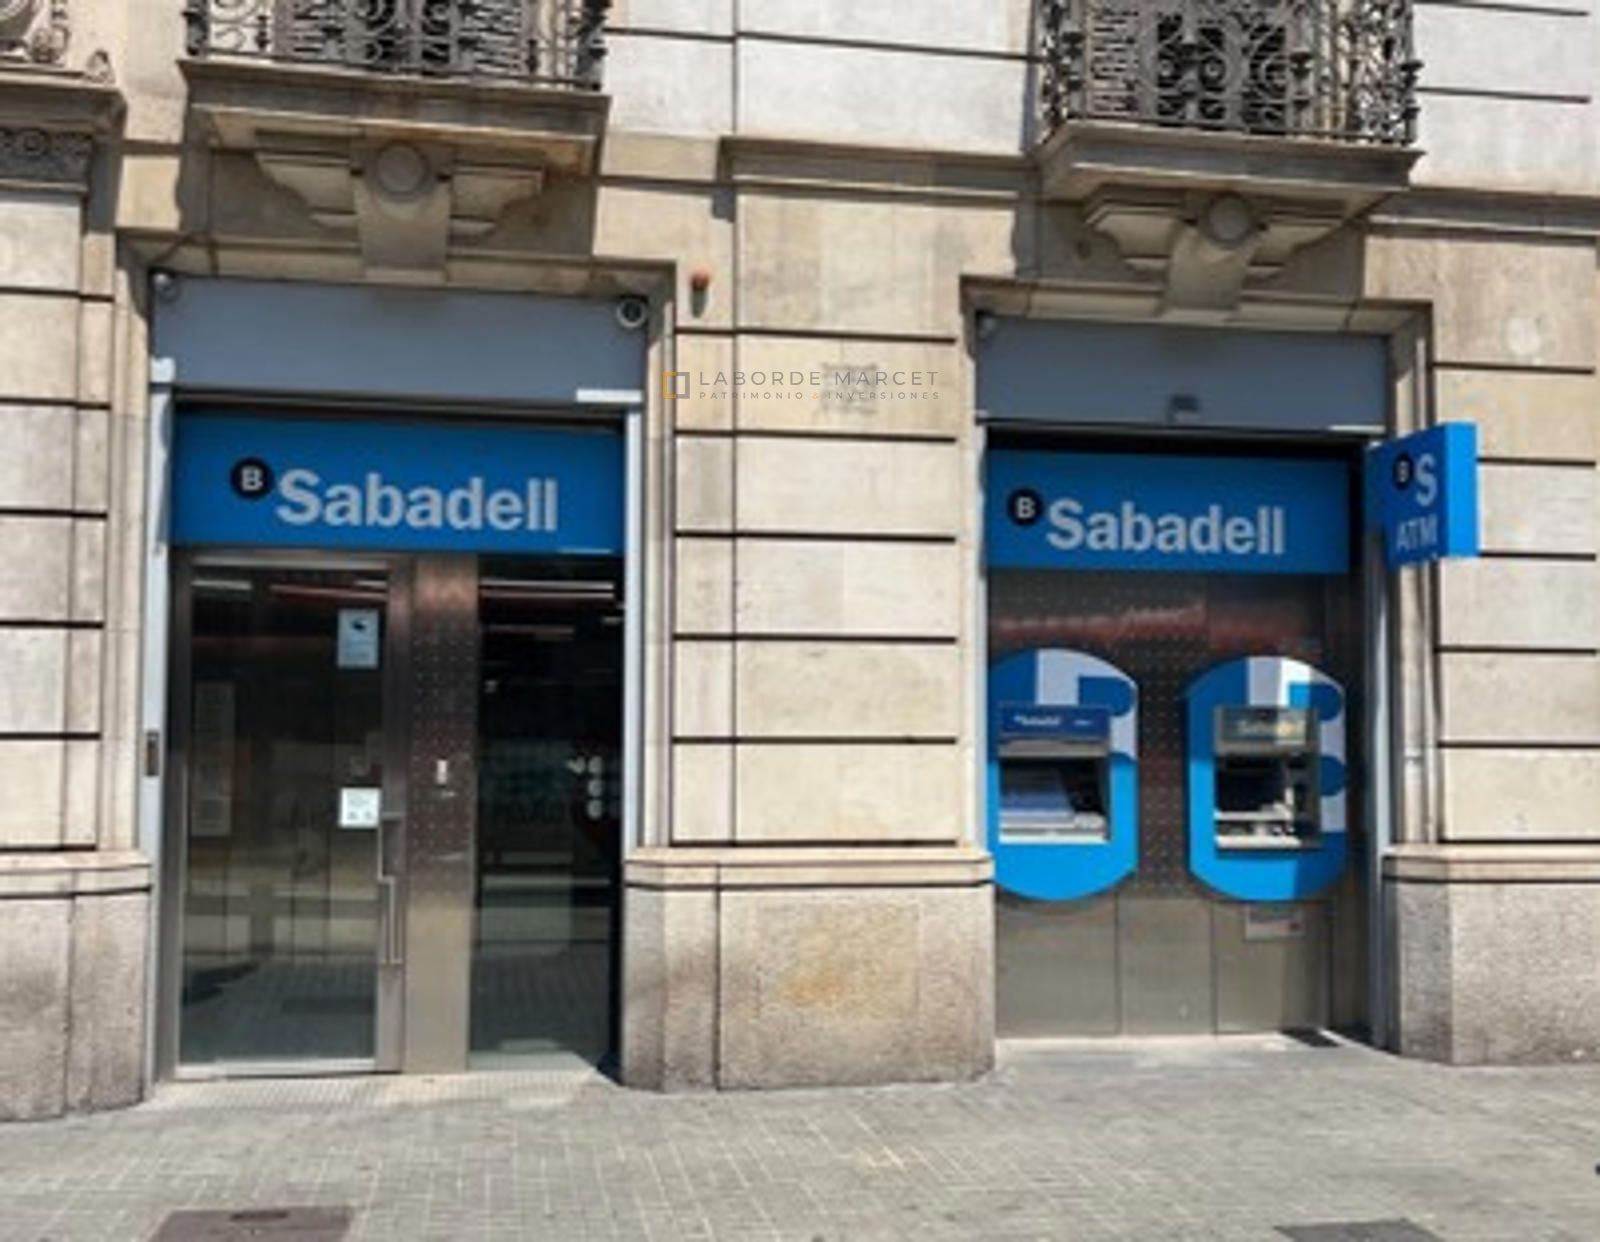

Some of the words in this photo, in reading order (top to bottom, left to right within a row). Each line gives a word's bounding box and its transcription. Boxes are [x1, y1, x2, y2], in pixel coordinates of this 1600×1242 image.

[240, 466, 264, 491] B
[275, 467, 559, 532] Sabadell
[1416, 452, 1438, 507] S
[1016, 497, 1035, 519] B
[1046, 498, 1287, 555] Sabadell
[1396, 513, 1438, 551] ATM
